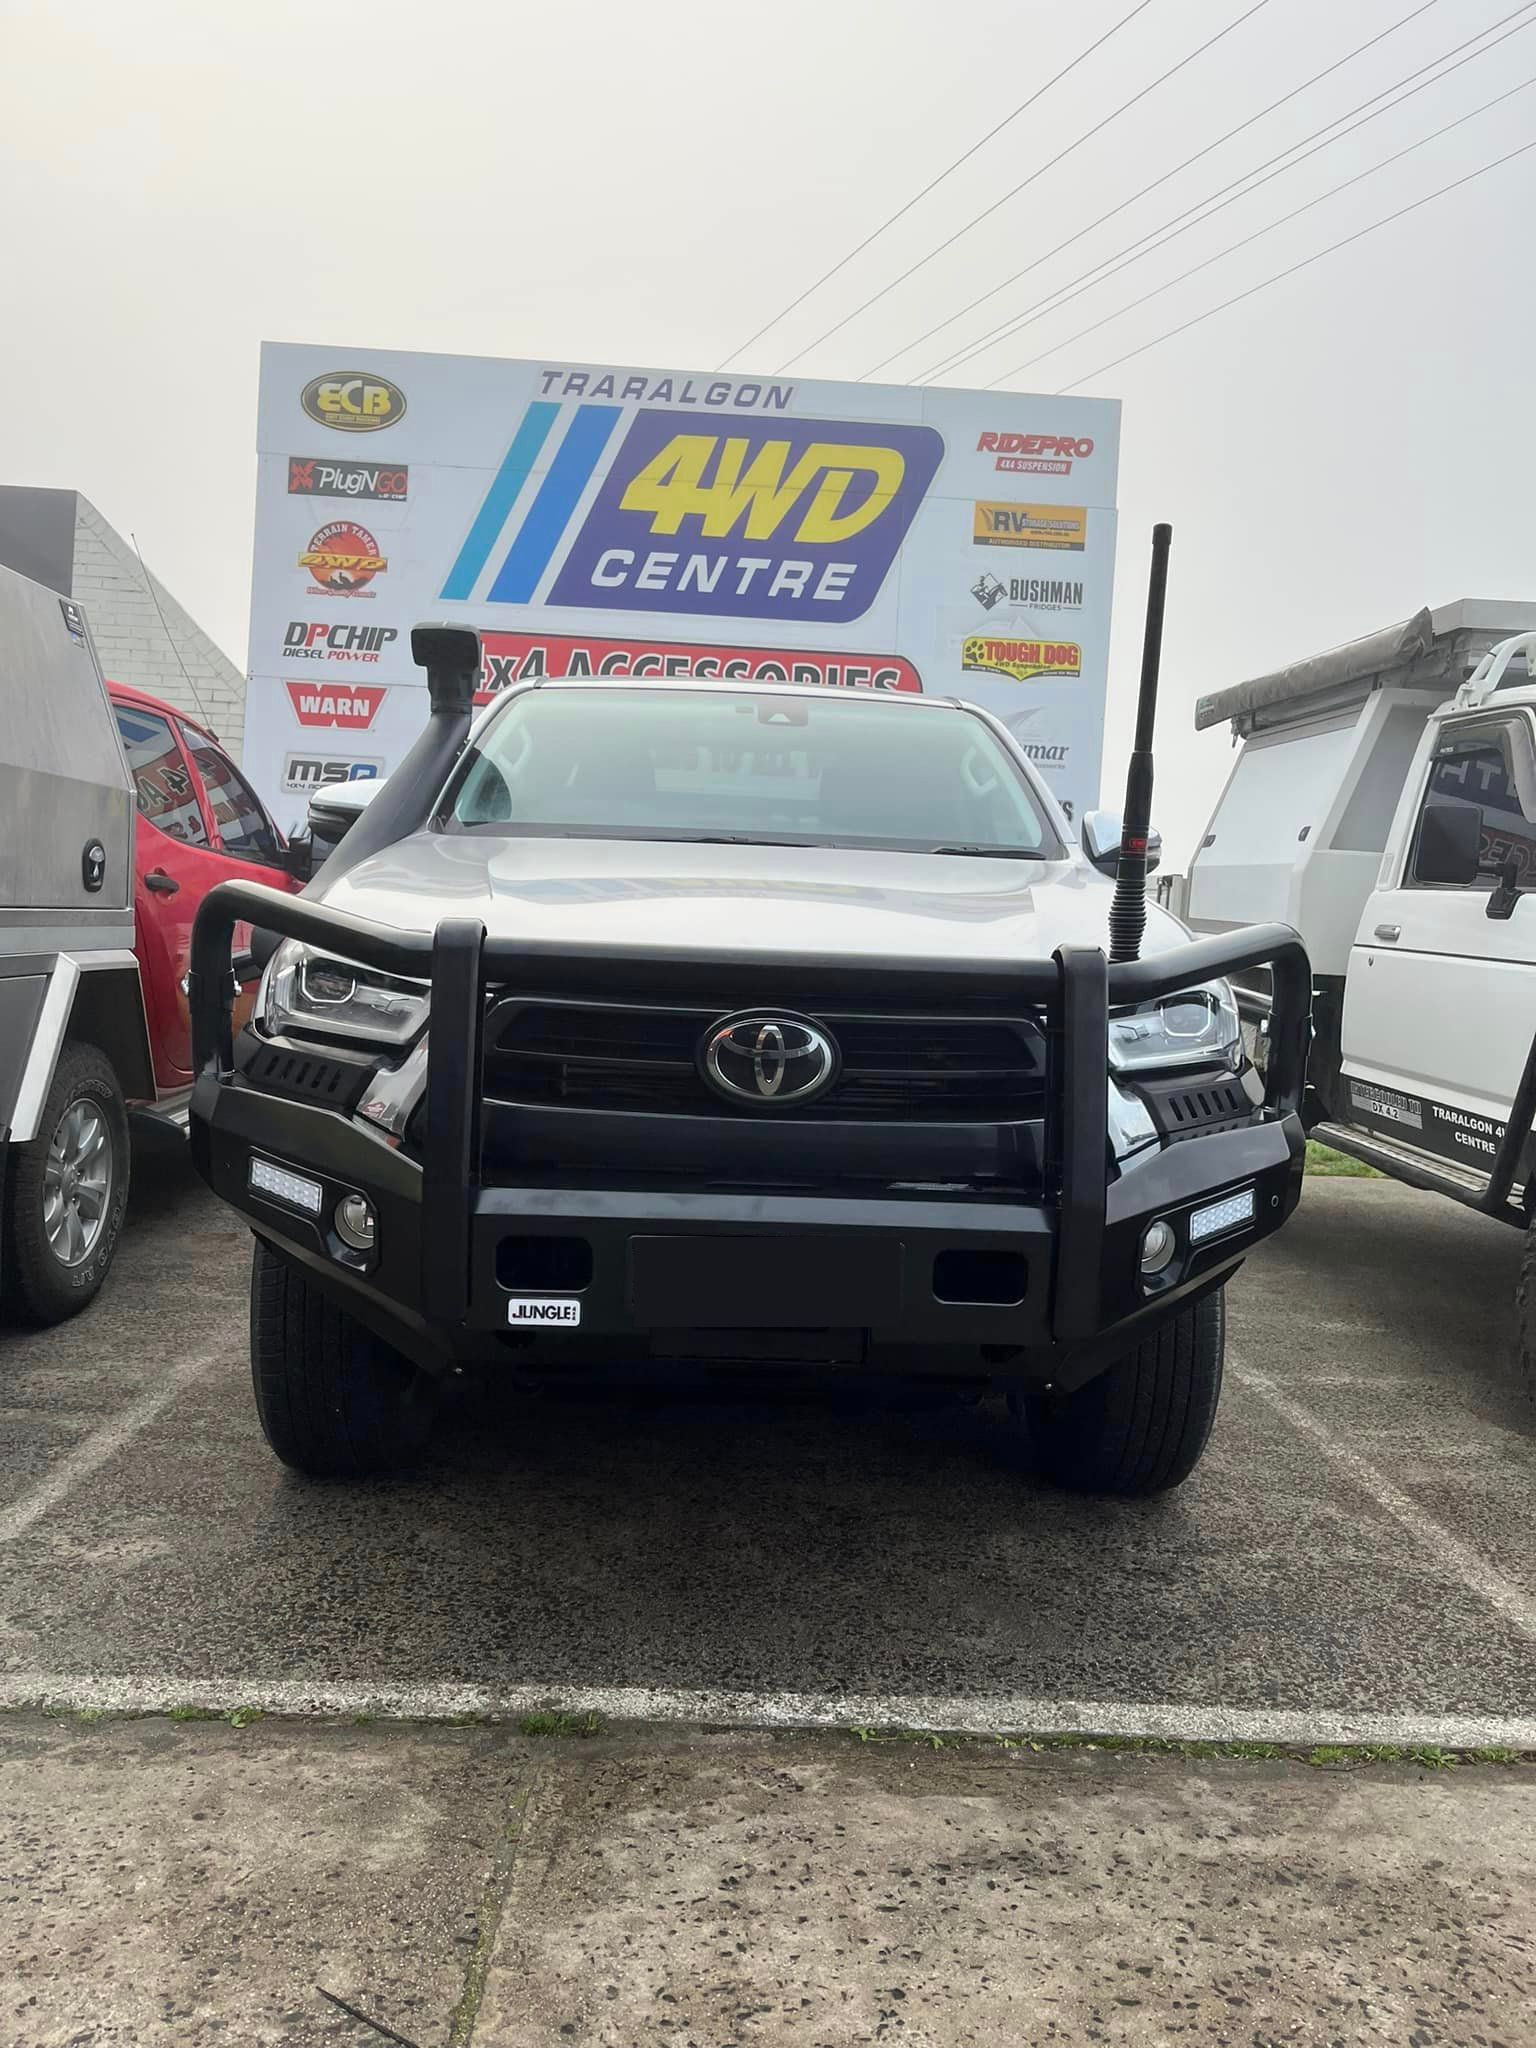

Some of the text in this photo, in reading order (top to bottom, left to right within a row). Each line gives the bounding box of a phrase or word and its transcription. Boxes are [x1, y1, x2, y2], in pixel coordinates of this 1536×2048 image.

[317, 380, 391, 416] ECB
[540, 370, 794, 411] TRARALGON
[977, 431, 1094, 458] RIDEPRO
[1016, 460, 1067, 473] SUSPENSION
[618, 434, 906, 544] 4WD
[992, 510, 1027, 533] RV
[310, 523, 377, 556] TERRAIN TAMER
[590, 549, 858, 601] CENTRE
[1009, 579, 1083, 605] BUSHMAN
[1029, 602, 1061, 611] FRIDGES
[282, 647, 379, 663] DIESEL POWER
[984, 640, 1079, 667] TOUGH DOG
[299, 695, 370, 717] WARN
[1372, 1102, 1384, 1115] DX
[1432, 1105, 1493, 1135] TRARALGON
[1454, 1131, 1497, 1155] CENTRE
[512, 1304, 571, 1321] JUNGLE
